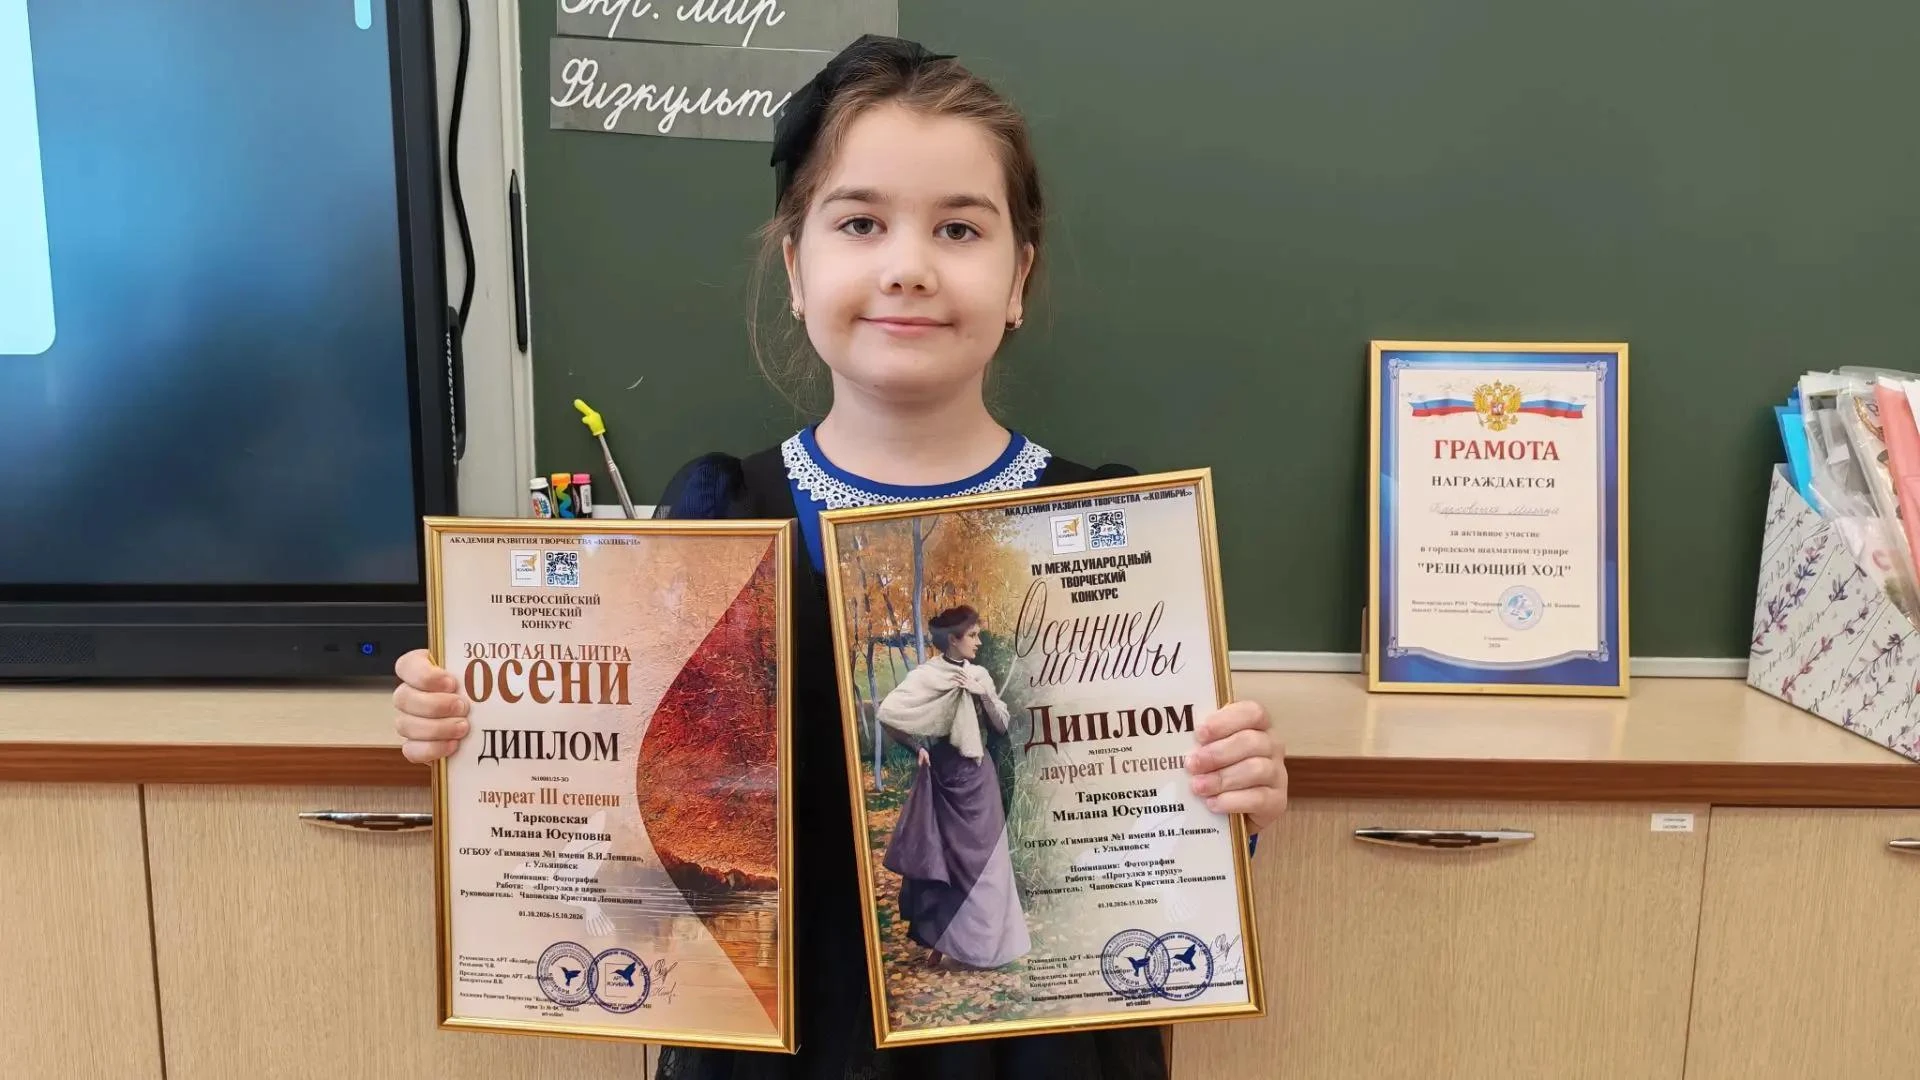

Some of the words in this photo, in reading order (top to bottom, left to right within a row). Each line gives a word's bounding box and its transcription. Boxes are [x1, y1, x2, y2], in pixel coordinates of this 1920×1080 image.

[560, 0, 659, 38] кр.
[550, 58, 791, 133] Физкульт
[1433, 439, 1560, 461] ГРАМОТА
[1431, 475, 1555, 489] НАГРАЖДАЕТСЯ
[1004, 505, 1050, 517] АКАДЕМИЯ
[1051, 499, 1092, 512] РАЗВИТИЯ
[1094, 493, 1141, 506] ТВОРЧЕСТВА
[1142, 488, 1193, 502] «КОЛИБРИ»
[450, 537, 495, 545] АКАДЕМИЯ
[496, 537, 538, 545] РАЗВИТИЯ
[540, 537, 592, 546] ТВОРЧЕСТВА
[1031, 564, 1042, 576] IV
[1044, 550, 1152, 575] МЕЖДУНАРОДНЫЙ
[1418, 562, 1527, 577] "РЕШАЮЩИЙ
[1531, 564, 1571, 578] ХОД"
[1061, 569, 1126, 589] ТВОРЧЕСКИЙ
[491, 594, 503, 604] III
[505, 593, 601, 605] ВСЕРОССИЙСКИЙ
[1071, 587, 1119, 603] КОНКУРС
[510, 606, 582, 618] ТВОРЧЕСКИЙ
[521, 619, 573, 630] КОНКУРС
[464, 642, 545, 660] ЗОЛОТАЯ
[550, 644, 632, 661] ПАЛИТРА
[478, 730, 620, 766] ДИПЛОМ
[1039, 761, 1105, 784] лауреат
[1109, 755, 1116, 774] I
[478, 790, 536, 809] лауреат
[540, 788, 557, 805] III
[562, 792, 620, 807] степени
[1075, 787, 1157, 804] Тарковская
[513, 811, 588, 825] Тарковская
[1052, 807, 1108, 822] Милана
[1112, 802, 1185, 820] Юсуповна
[491, 826, 542, 839] Милана
[546, 827, 612, 843] Юсуповна
[1024, 838, 1058, 848] ОГБОУ
[1060, 835, 1108, 846] «Гимназия
[1128, 832, 1156, 840] имени
[459, 847, 491, 856] ОГБОУ
[494, 848, 540, 857] «Гимназия
[558, 852, 585, 860] имени
[1102, 842, 1150, 853] Ульяновск
[533, 860, 578, 870] Ульяновск
[1135, 878, 1175, 888] Кристина
